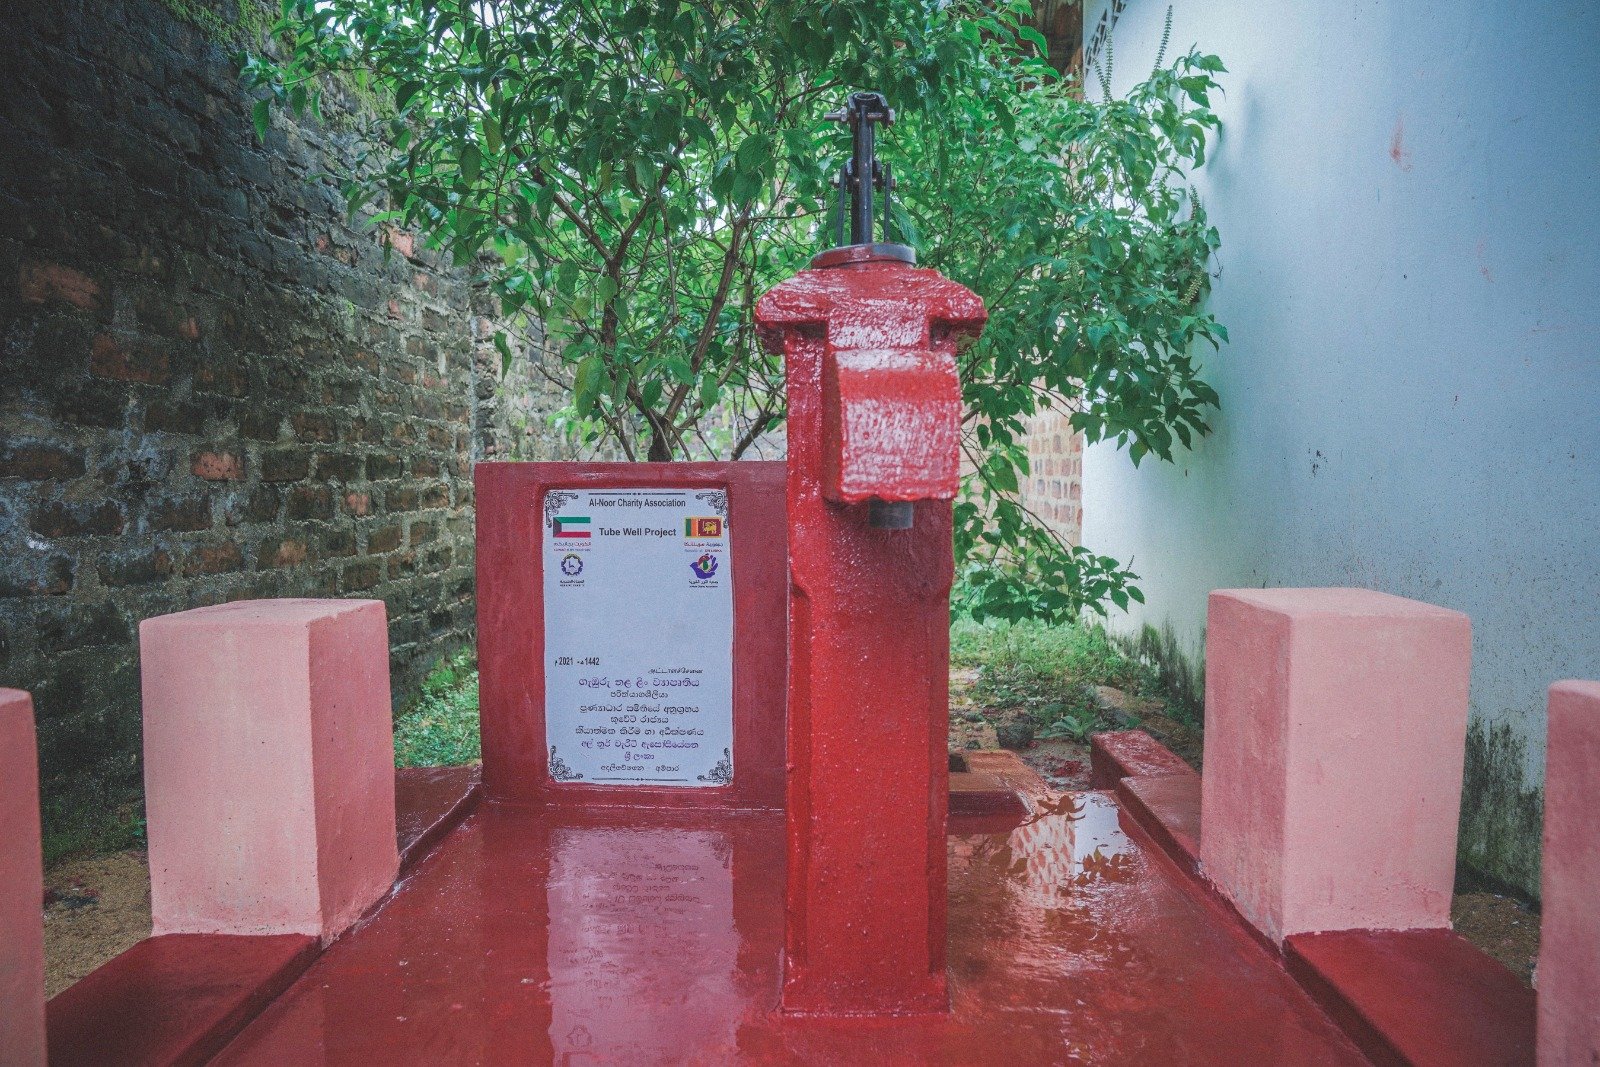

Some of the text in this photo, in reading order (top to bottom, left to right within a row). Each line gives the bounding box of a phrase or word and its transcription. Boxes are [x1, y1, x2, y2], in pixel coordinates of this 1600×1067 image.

[589, 498, 686, 509] Al-Noor Charity Association
[599, 527, 677, 538] Tube Well Project
